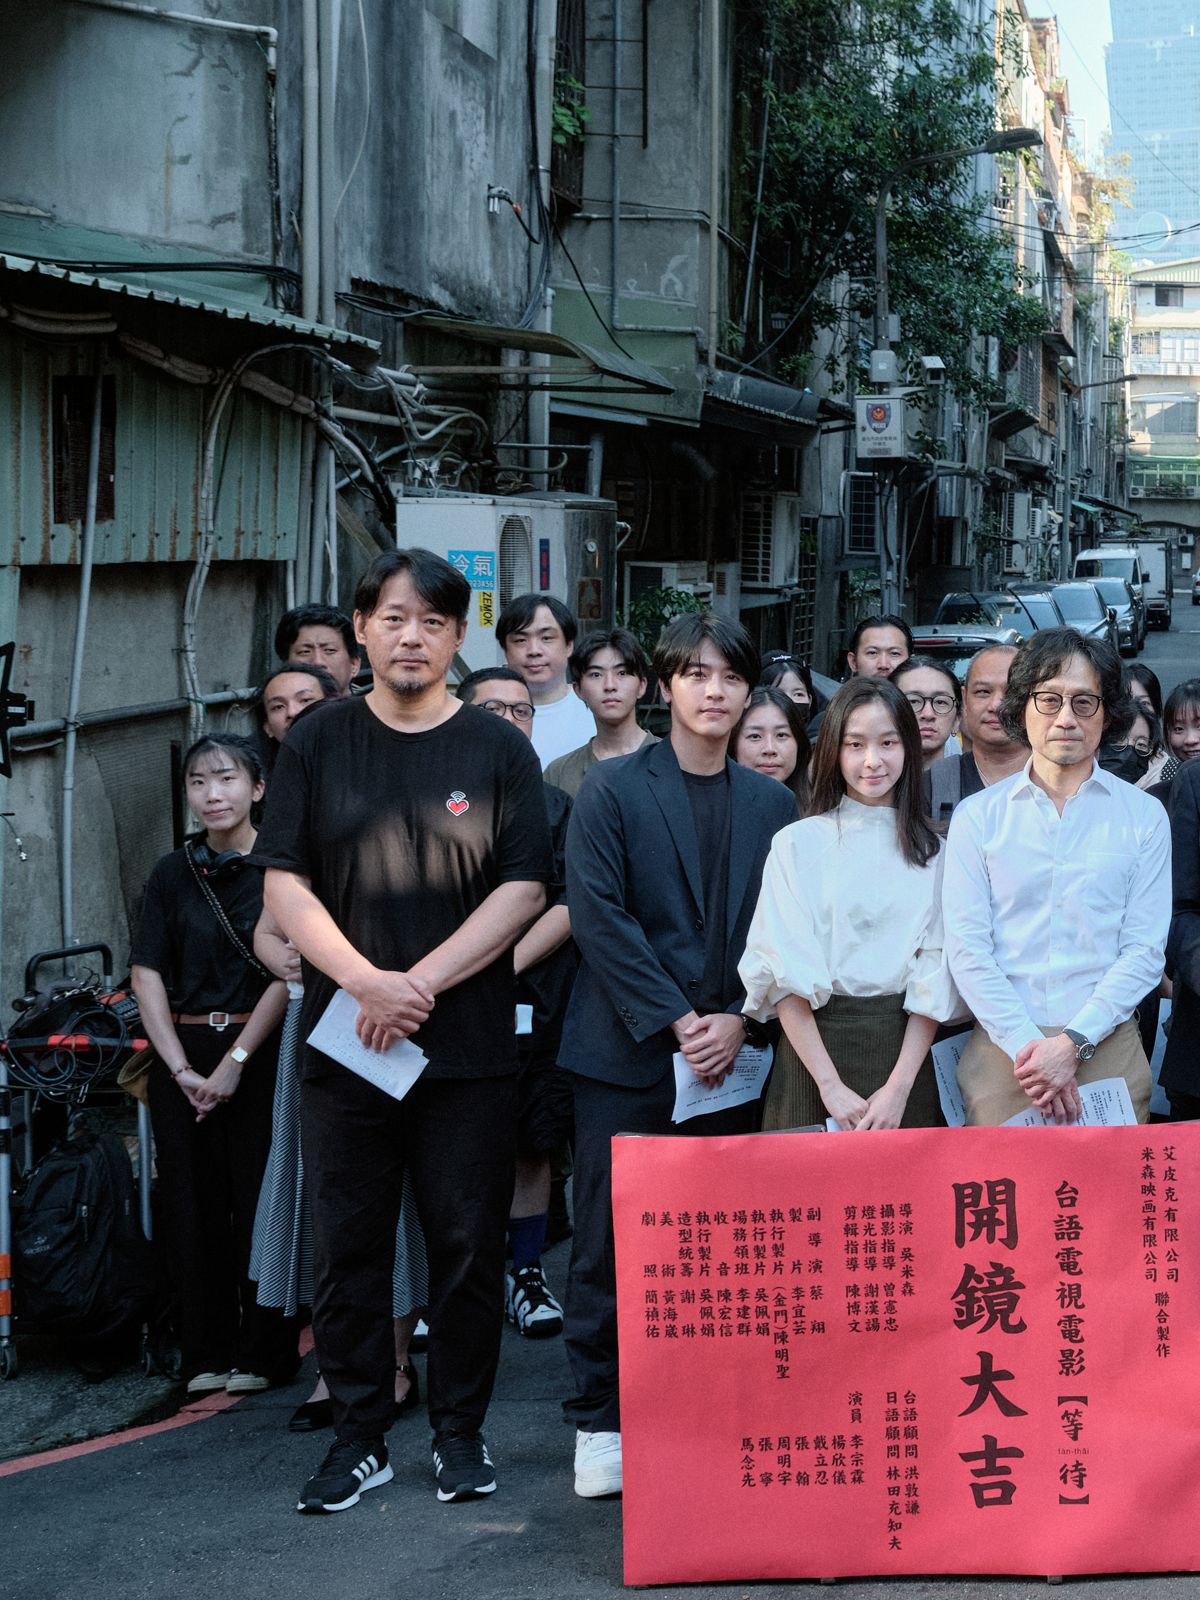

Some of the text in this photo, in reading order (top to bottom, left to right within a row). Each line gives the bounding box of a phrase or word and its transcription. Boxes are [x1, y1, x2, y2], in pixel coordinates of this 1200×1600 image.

[450, 554, 493, 577] 冷氣
[483, 591, 493, 626] ZEMOK
[676, 1210, 695, 1278] 造型統籌
[694, 1210, 712, 1278] 執行製片
[750, 1209, 768, 1277] 執行製片
[768, 1208, 786, 1276] 執行製片
[861, 1204, 878, 1272] 燈光指導
[1140, 1146, 1158, 1283] 米森映画有限公司
[1162, 1145, 1180, 1283] 艾皮克有限公司
[732, 1209, 753, 1337] 場務領班 李建群
[842, 1205, 863, 1333] 剪輯指導 陳博文
[879, 1203, 900, 1333] 攝影指導 曾憲忠
[898, 1202, 916, 1297] 導演 吳米森
[1052, 1179, 1086, 1377] 台語電視電影
[716, 1287, 734, 1338] 陳宏信
[791, 1285, 807, 1336] 李宜芸
[950, 1177, 1029, 1509] 開鏡大吉
[1154, 1291, 1171, 1359] 聯合製作
[848, 1390, 865, 1485] 演員 李宗霖
[884, 1391, 901, 1460] 日語顧問
[902, 1389, 921, 1516] 台語顧問 洪敦謙
[740, 1436, 757, 1488] 馬念先
[776, 1435, 793, 1487] 周明宇
[812, 1434, 829, 1486] 戴立忍
